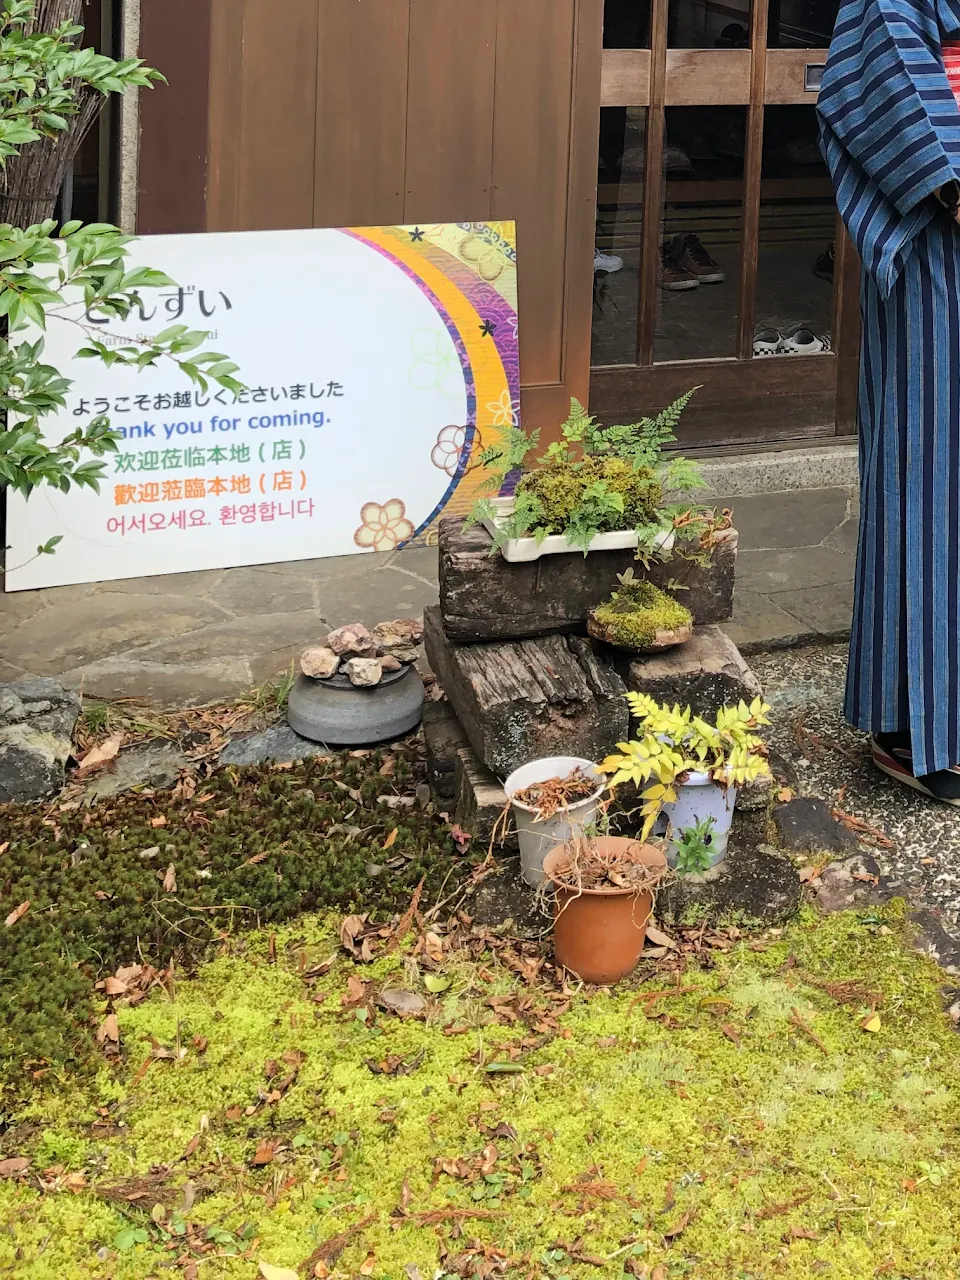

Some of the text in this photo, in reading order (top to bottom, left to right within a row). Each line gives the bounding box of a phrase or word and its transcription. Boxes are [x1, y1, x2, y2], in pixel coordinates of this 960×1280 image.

[163, 419, 203, 440] you
[209, 415, 242, 433] for
[247, 409, 331, 429] coming.
[106, 497, 316, 536] 어서오세요. 환영합니다
